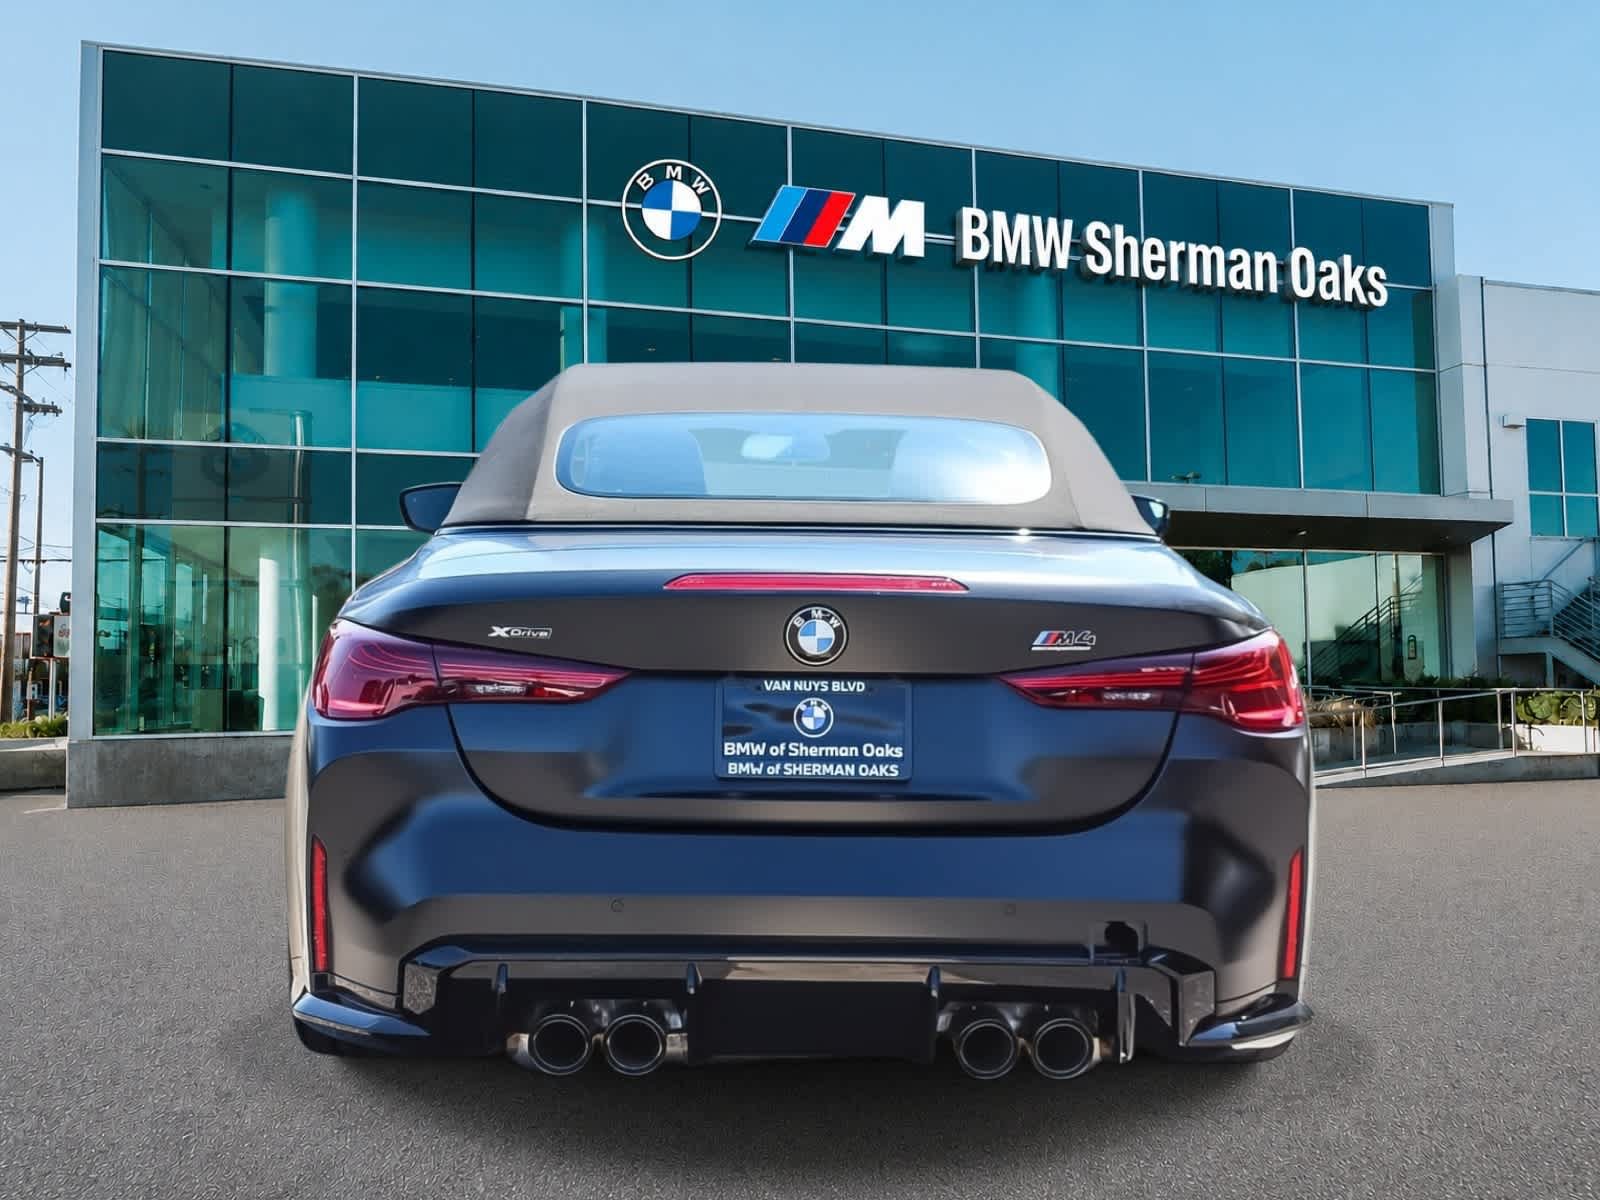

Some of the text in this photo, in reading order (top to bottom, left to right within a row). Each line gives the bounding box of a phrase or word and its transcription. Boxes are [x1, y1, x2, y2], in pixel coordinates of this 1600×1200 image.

[635, 164, 711, 195] BMW
[961, 206, 1388, 308] BMW Sherman Oaks
[793, 609, 841, 629] BMW
[764, 680, 865, 692] VAN NUYS BLVD
[724, 742, 903, 758] BMW of Sherman Oaks
[727, 762, 899, 777] BMW of SHERMAN OAKS
